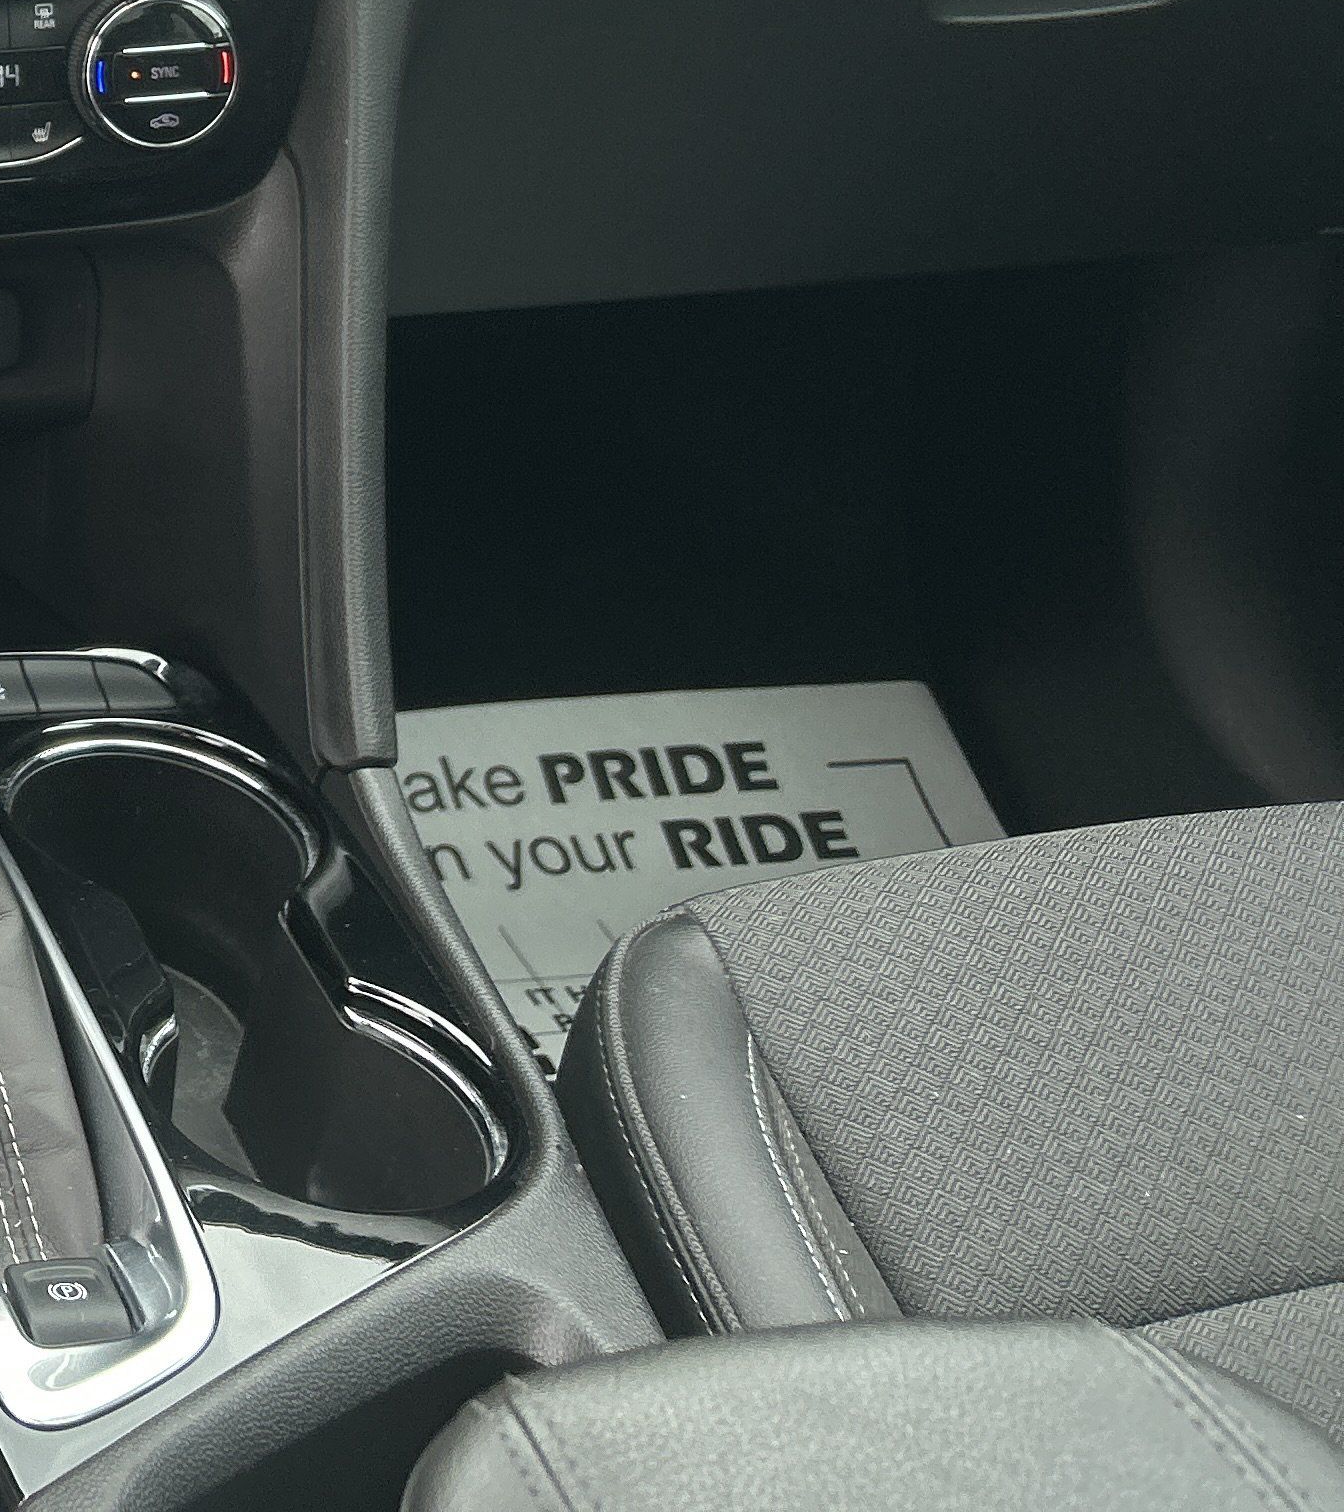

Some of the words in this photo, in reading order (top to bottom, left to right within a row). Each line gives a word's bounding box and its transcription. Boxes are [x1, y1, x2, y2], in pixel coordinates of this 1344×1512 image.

[150, 65, 180, 80] SYNC
[404, 754, 526, 813] ake
[537, 741, 780, 805] PRIDE
[425, 842, 472, 881] n
[484, 829, 636, 892] your
[660, 809, 860, 871] RIDE
